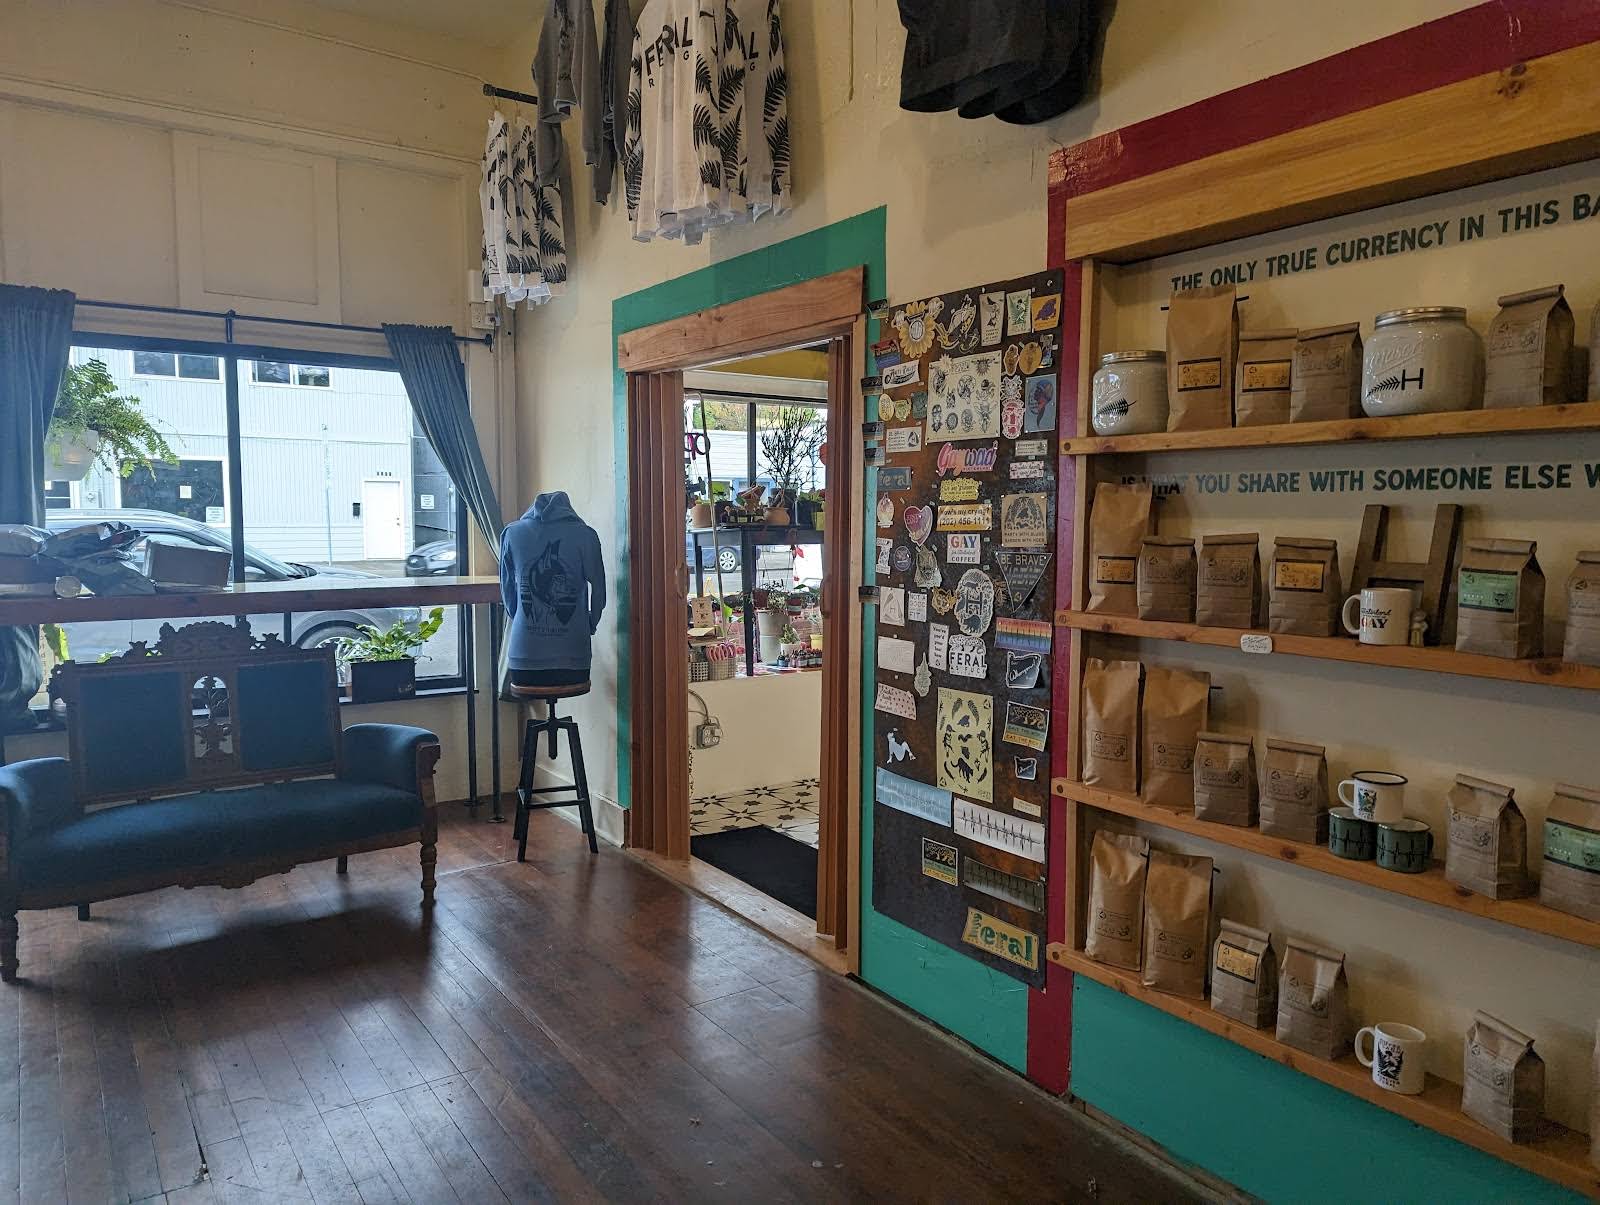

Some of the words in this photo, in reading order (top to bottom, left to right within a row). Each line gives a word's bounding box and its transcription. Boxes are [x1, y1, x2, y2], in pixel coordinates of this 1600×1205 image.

[1171, 272, 1203, 291] THE
[1210, 260, 1258, 287] ONLY
[1266, 248, 1318, 278] TRUE
[1325, 220, 1449, 266] CURRENCY
[1459, 214, 1485, 242] IN
[1498, 199, 1560, 233] THIS
[1196, 474, 1230, 494] YOU
[1238, 472, 1300, 493] SHARE
[1308, 469, 1364, 493] WITH
[1373, 466, 1493, 491] SOMEONE
[1504, 464, 1572, 489] ELSE
[951, 535, 978, 548] GAY
[1001, 553, 1013, 565] BE
[1015, 554, 1045, 566] BRAVE
[950, 652, 987, 668] FERAL
